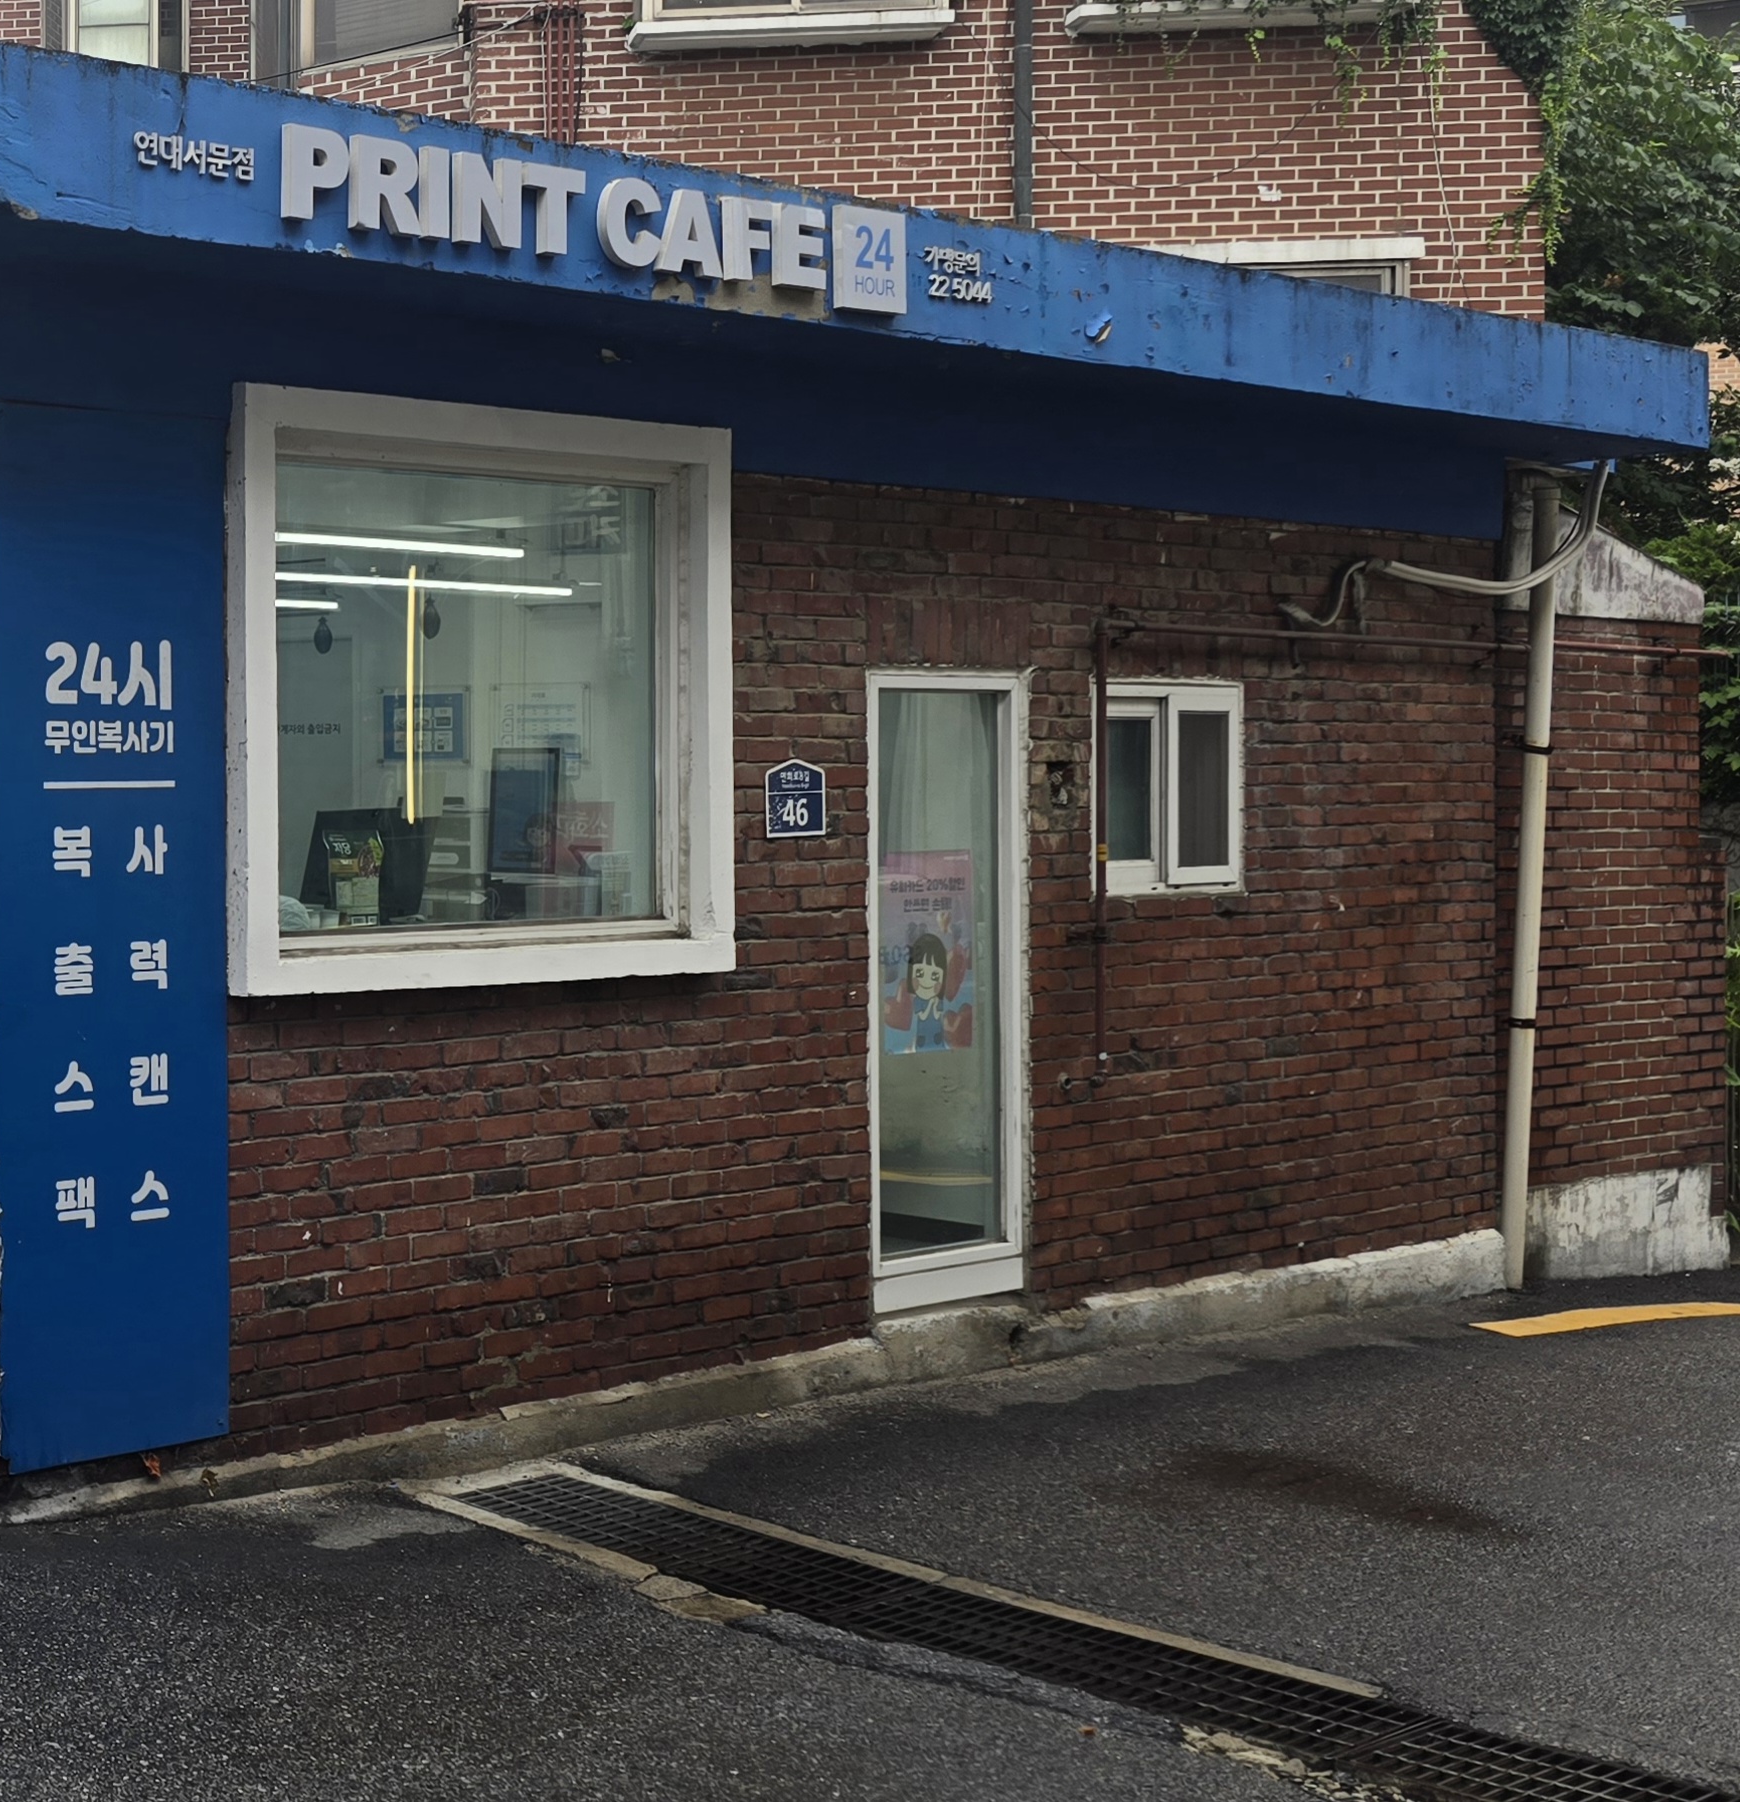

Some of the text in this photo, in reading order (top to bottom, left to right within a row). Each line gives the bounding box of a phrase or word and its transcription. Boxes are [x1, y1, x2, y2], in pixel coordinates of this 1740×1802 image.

[133, 131, 254, 181] 연대서문점
[281, 122, 828, 291] PRINT CAFE
[855, 225, 894, 272] 24
[924, 246, 981, 277] 가맹문의
[854, 275, 896, 298] HOUR
[45, 639, 172, 711] 24시
[44, 719, 174, 754] 무인복사기
[278, 723, 341, 736] 계자외 출입금지
[782, 797, 809, 827] 46
